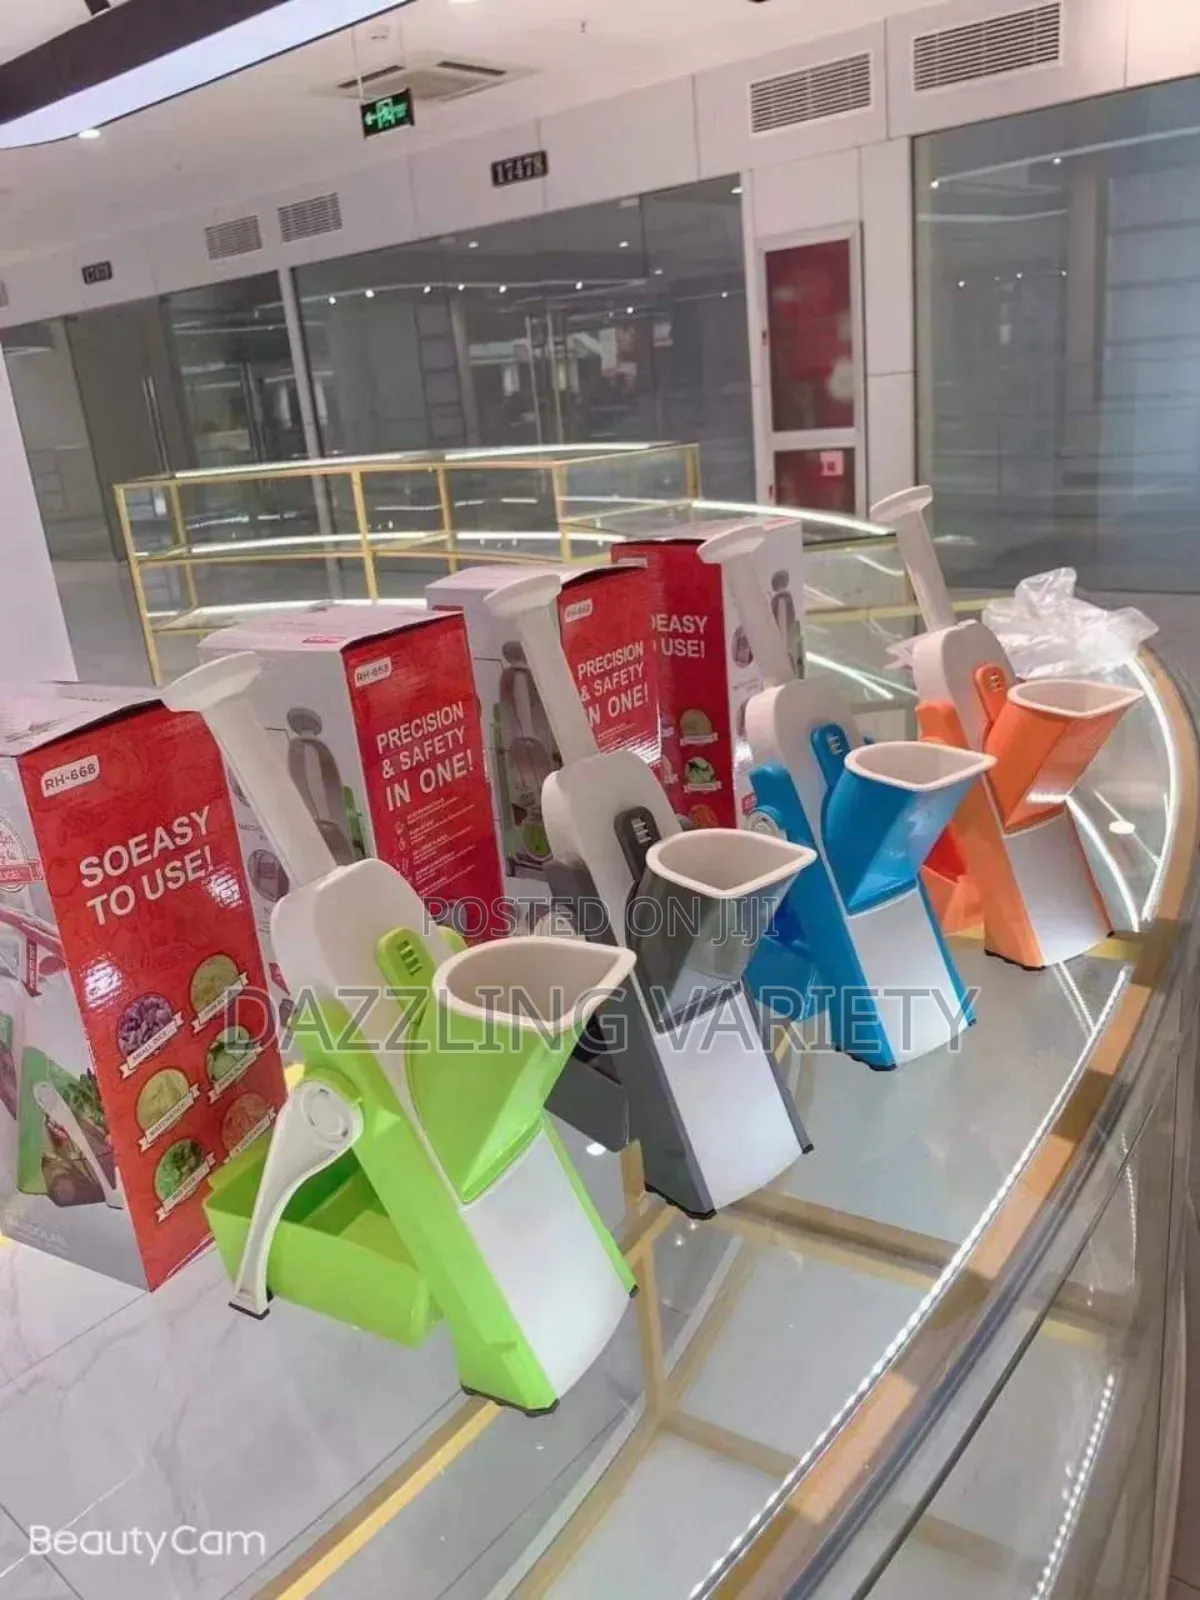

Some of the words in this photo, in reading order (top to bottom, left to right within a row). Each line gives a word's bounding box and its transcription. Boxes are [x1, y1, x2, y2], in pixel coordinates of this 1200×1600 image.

[494, 155, 544, 184] 17478
[577, 640, 644, 680] PRECISION
[661, 638, 705, 658] USE!
[581, 685, 590, 700] &
[594, 662, 644, 697] SAFETY
[588, 703, 600, 727] N
[608, 682, 649, 718] ONE!
[376, 701, 464, 754] PRECISION
[382, 759, 395, 779] &
[400, 725, 465, 771] SAFETY
[44, 763, 97, 791] RH-668
[386, 779, 411, 811] IN
[420, 749, 473, 793] ONE!
[79, 805, 210, 888] SOEASY
[86, 885, 136, 925] TO
[142, 845, 213, 900] USE!
